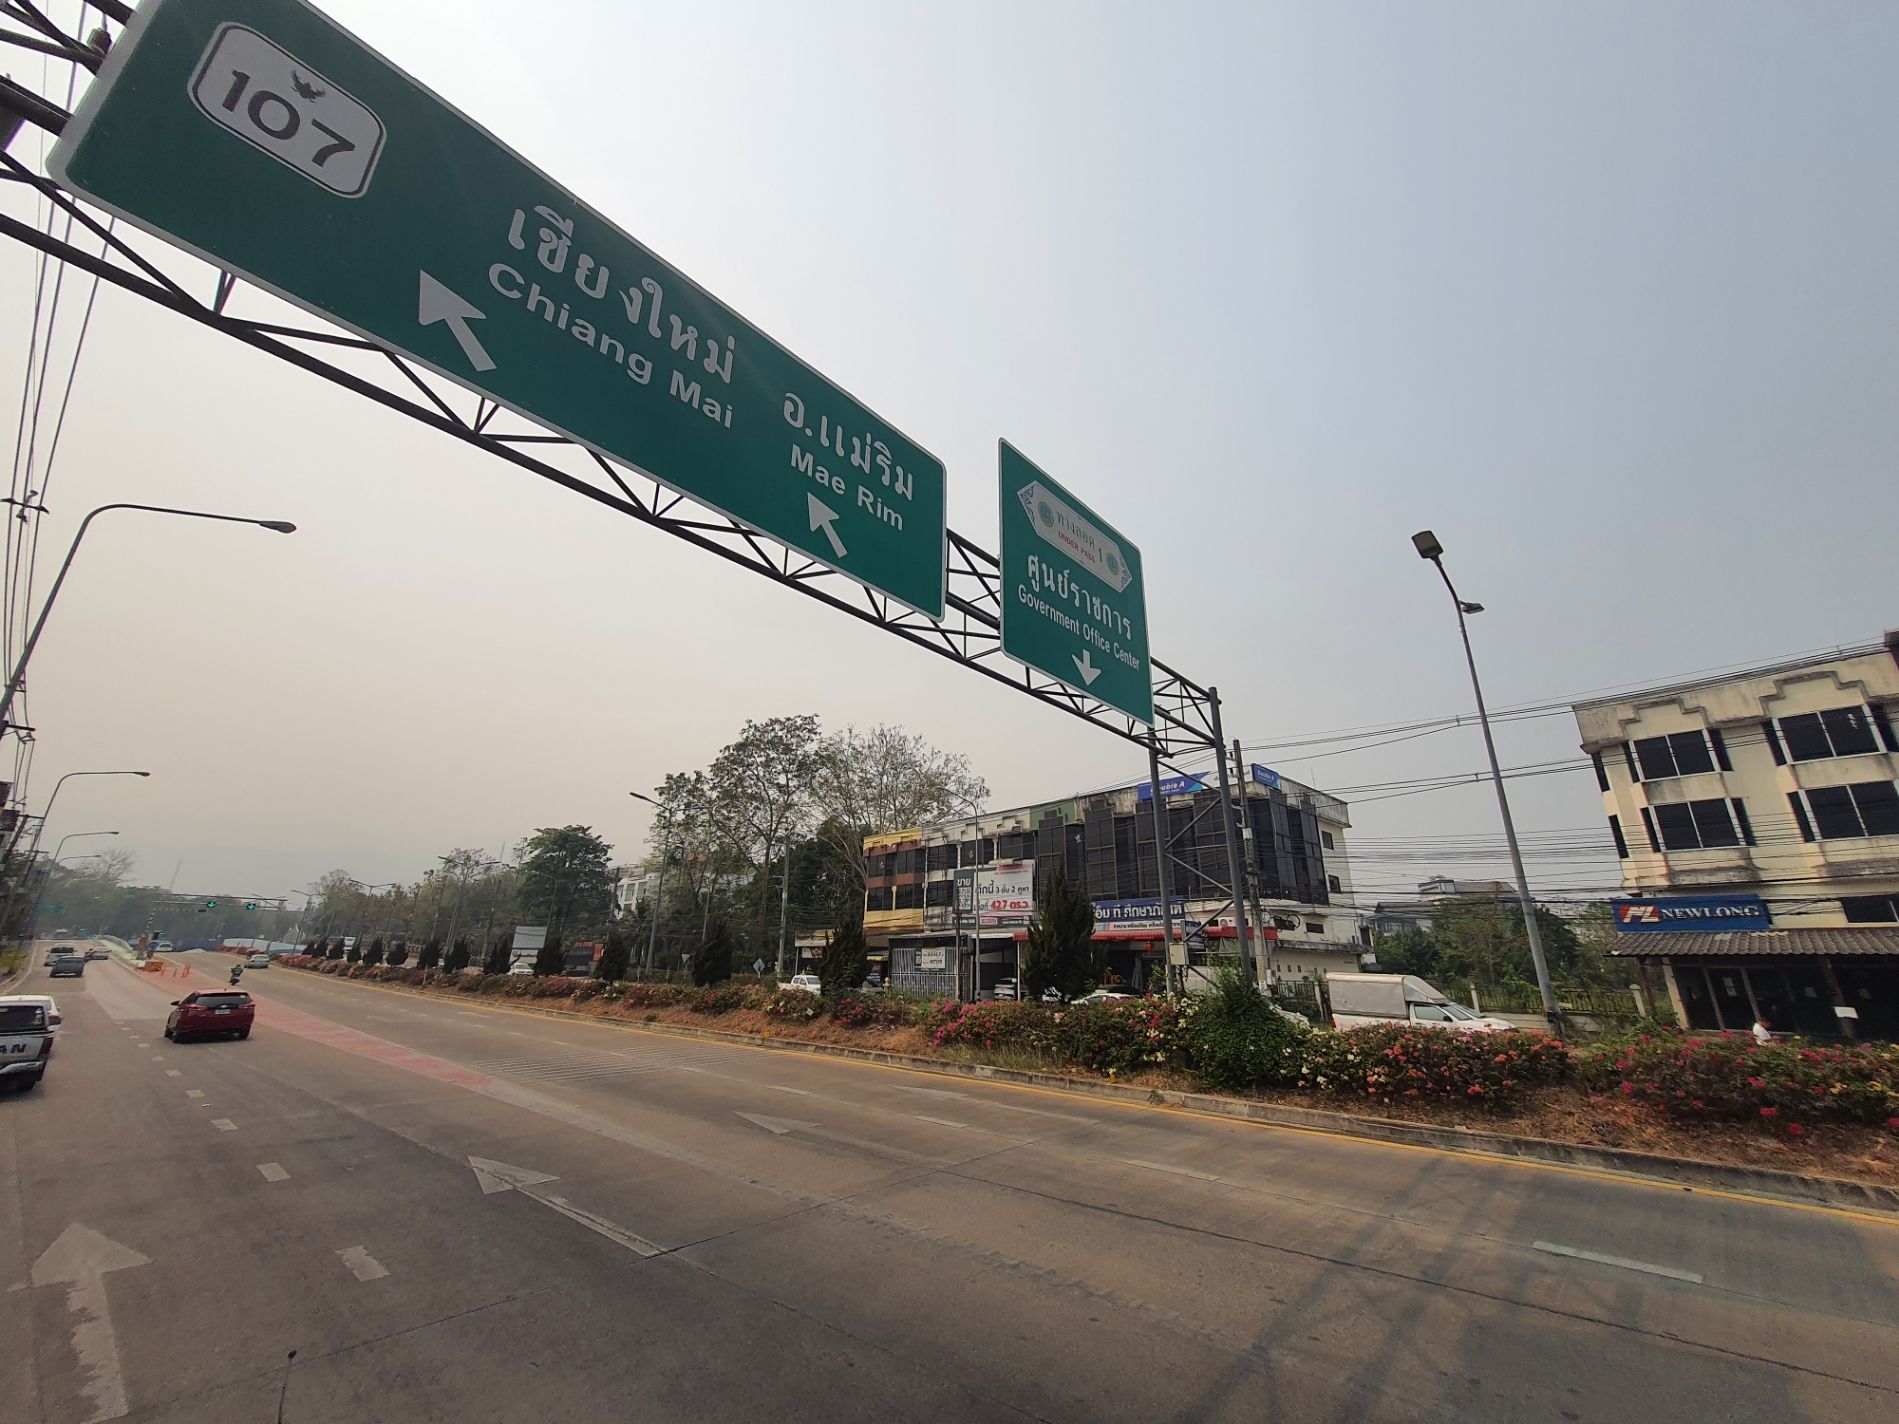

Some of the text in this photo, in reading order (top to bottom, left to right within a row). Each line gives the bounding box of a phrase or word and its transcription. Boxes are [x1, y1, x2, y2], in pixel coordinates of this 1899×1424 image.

[222, 70, 355, 167] 107
[508, 205, 735, 384] เชียงใหม่
[488, 263, 733, 429] Chiang Mai
[783, 392, 913, 501] อ.แม่ริม
[790, 444, 903, 531] Mae Rim
[1058, 531, 1096, 563] UNDER PASS
[1018, 584, 1140, 670] Government Office Center
[1028, 554, 1131, 640] ศูนย์ราชการ
[1660, 905, 1760, 919] NEWLONG
